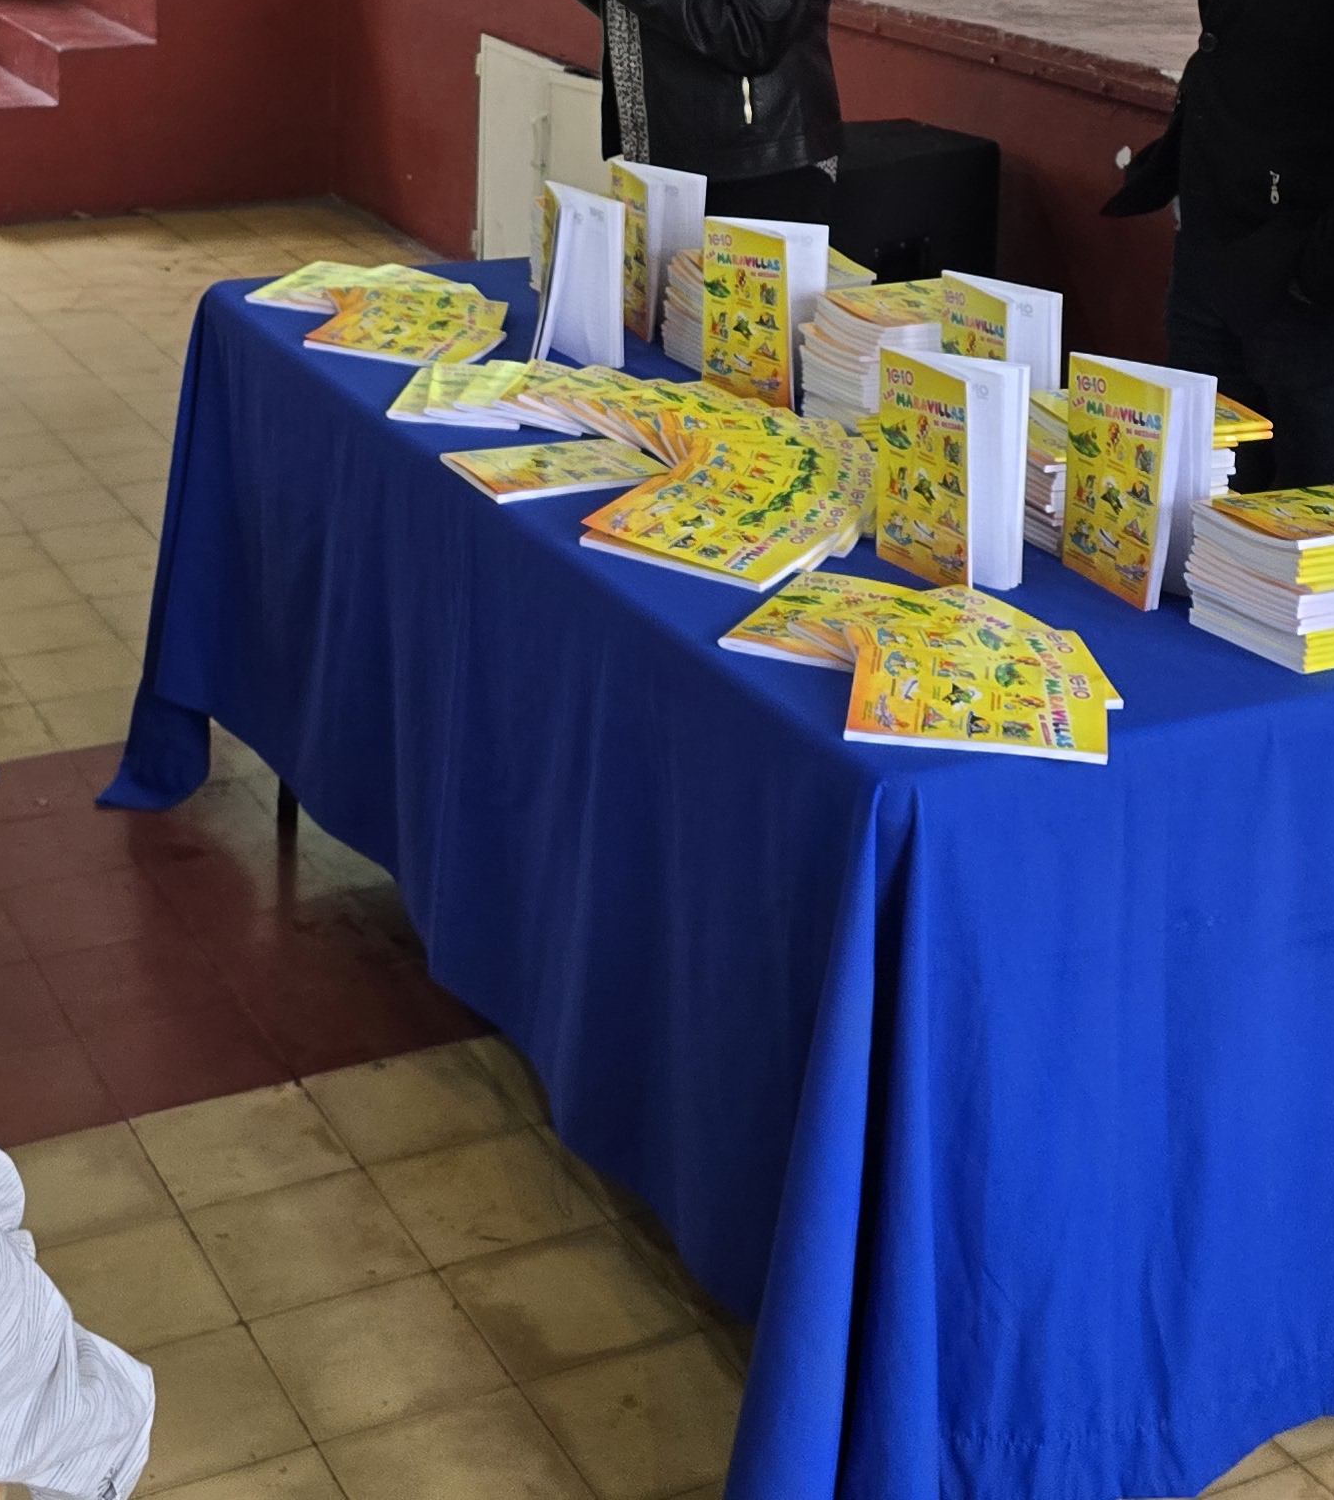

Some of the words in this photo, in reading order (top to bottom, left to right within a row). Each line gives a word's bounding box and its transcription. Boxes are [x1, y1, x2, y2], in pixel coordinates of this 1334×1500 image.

[717, 252, 781, 272] MARAVILLAS
[896, 392, 965, 423] MARAVILLAS
[1086, 400, 1162, 431] MARAVILLAS
